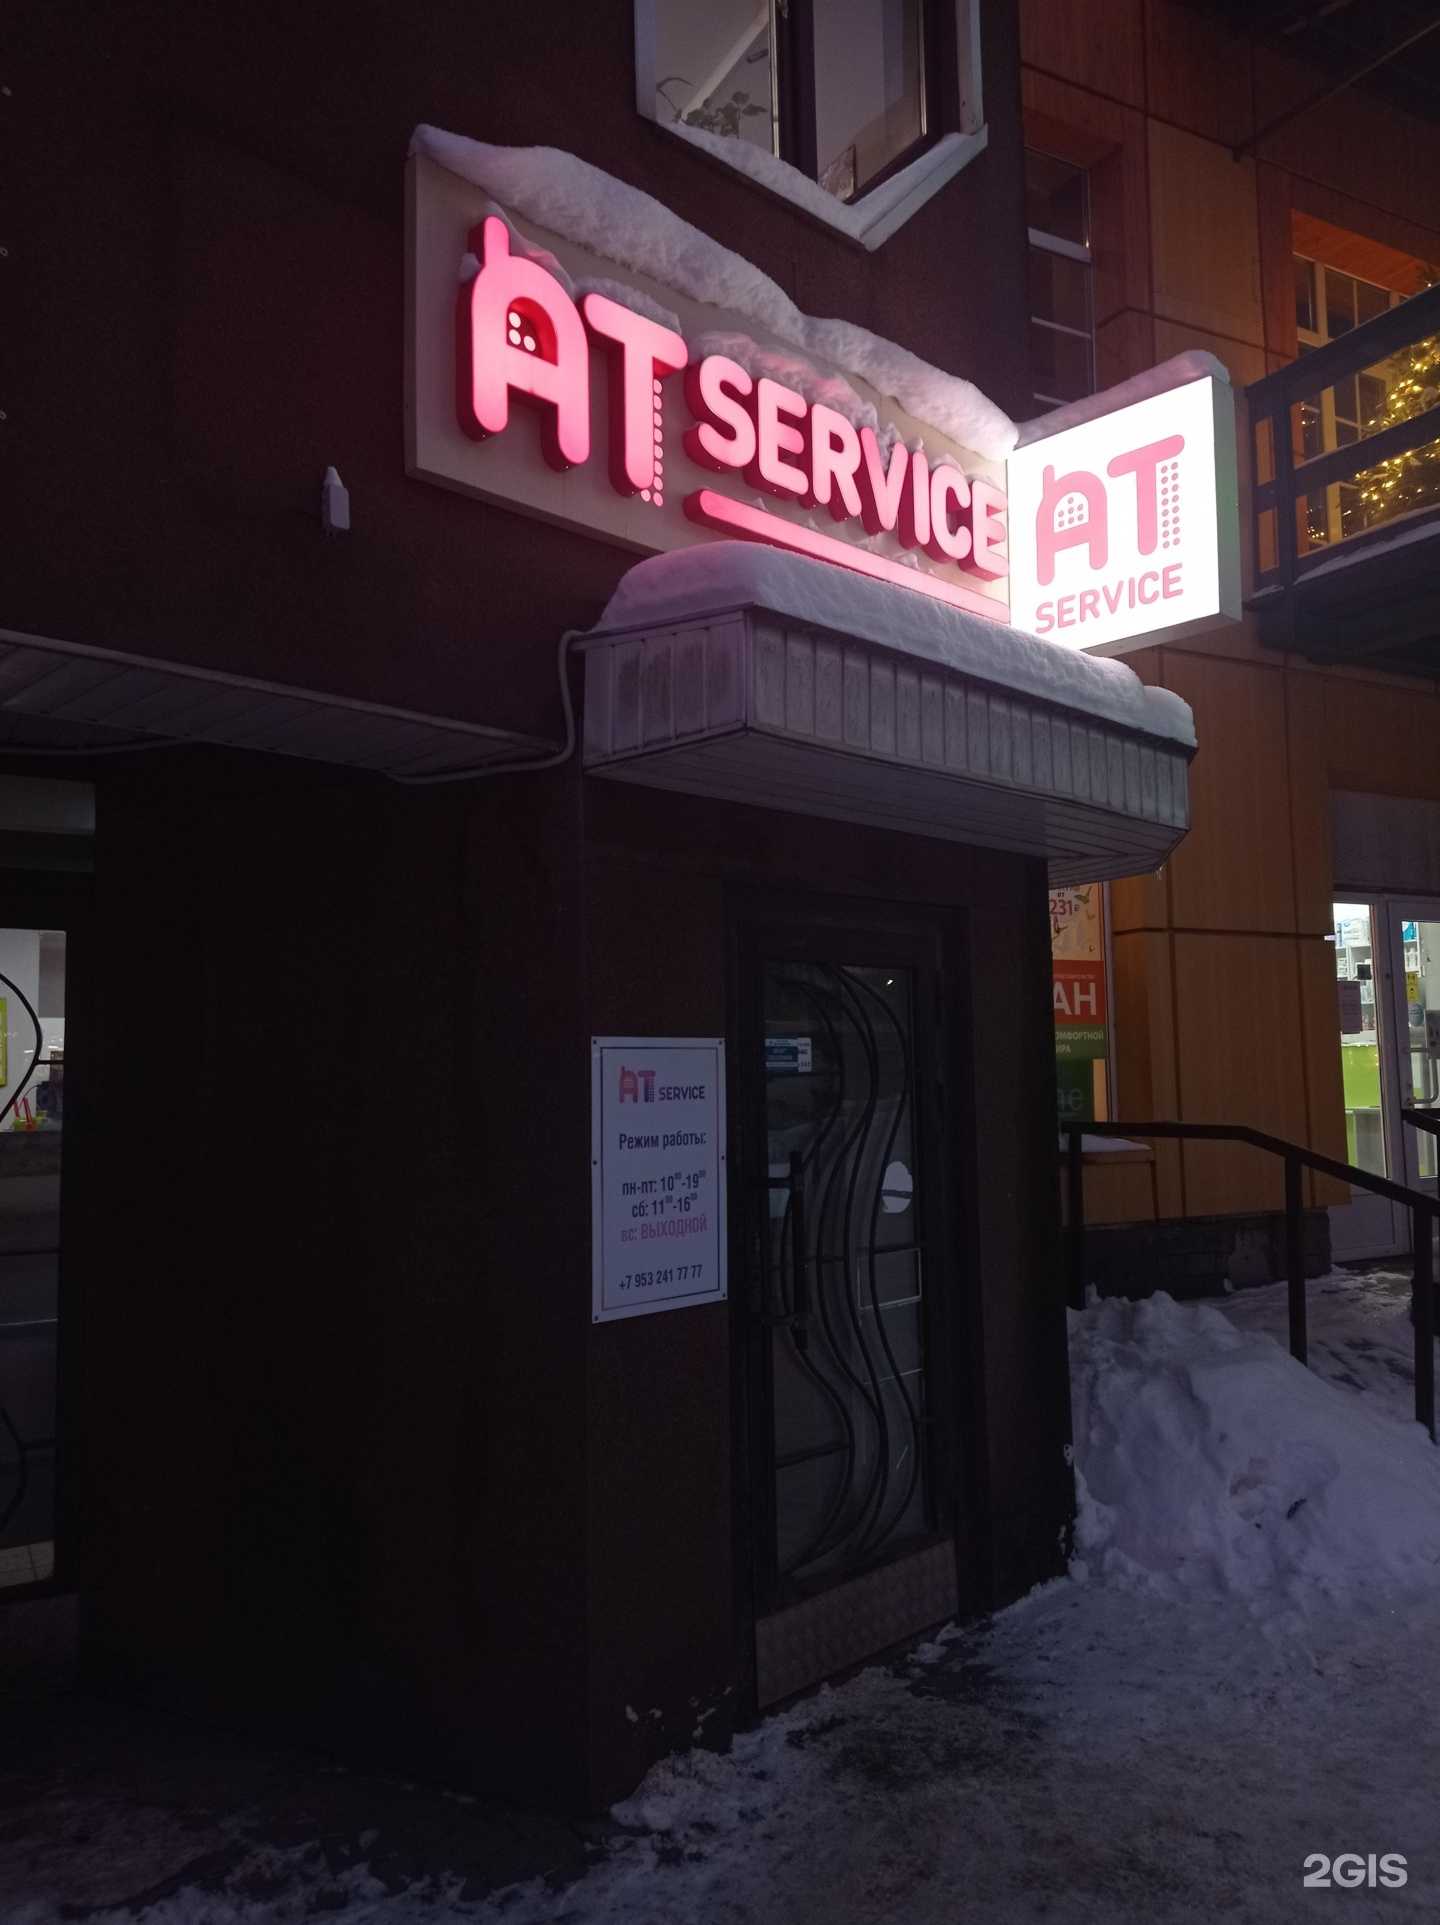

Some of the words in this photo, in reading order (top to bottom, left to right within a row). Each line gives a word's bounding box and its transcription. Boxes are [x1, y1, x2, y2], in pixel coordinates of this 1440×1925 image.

[464, 216, 688, 498] AT
[698, 354, 1009, 580] SERVICE
[1036, 434, 1186, 586] AT
[1035, 562, 1184, 634] SERVICE
[618, 1066, 656, 1103] AT
[658, 1085, 705, 1102] SERVICE
[619, 1133, 659, 1151] Режим
[662, 1130, 707, 1149] работы:
[622, 1180, 657, 1196] пн-пт:
[631, 1200, 649, 1218] сб:
[640, 1215, 707, 1241] ВЫХОДНОЙ
[619, 1274, 632, 1291] +7
[634, 1270, 653, 1288] 953
[656, 1267, 674, 1285] 241
[677, 1265, 689, 1281] 77
[691, 1263, 703, 1280] 77
